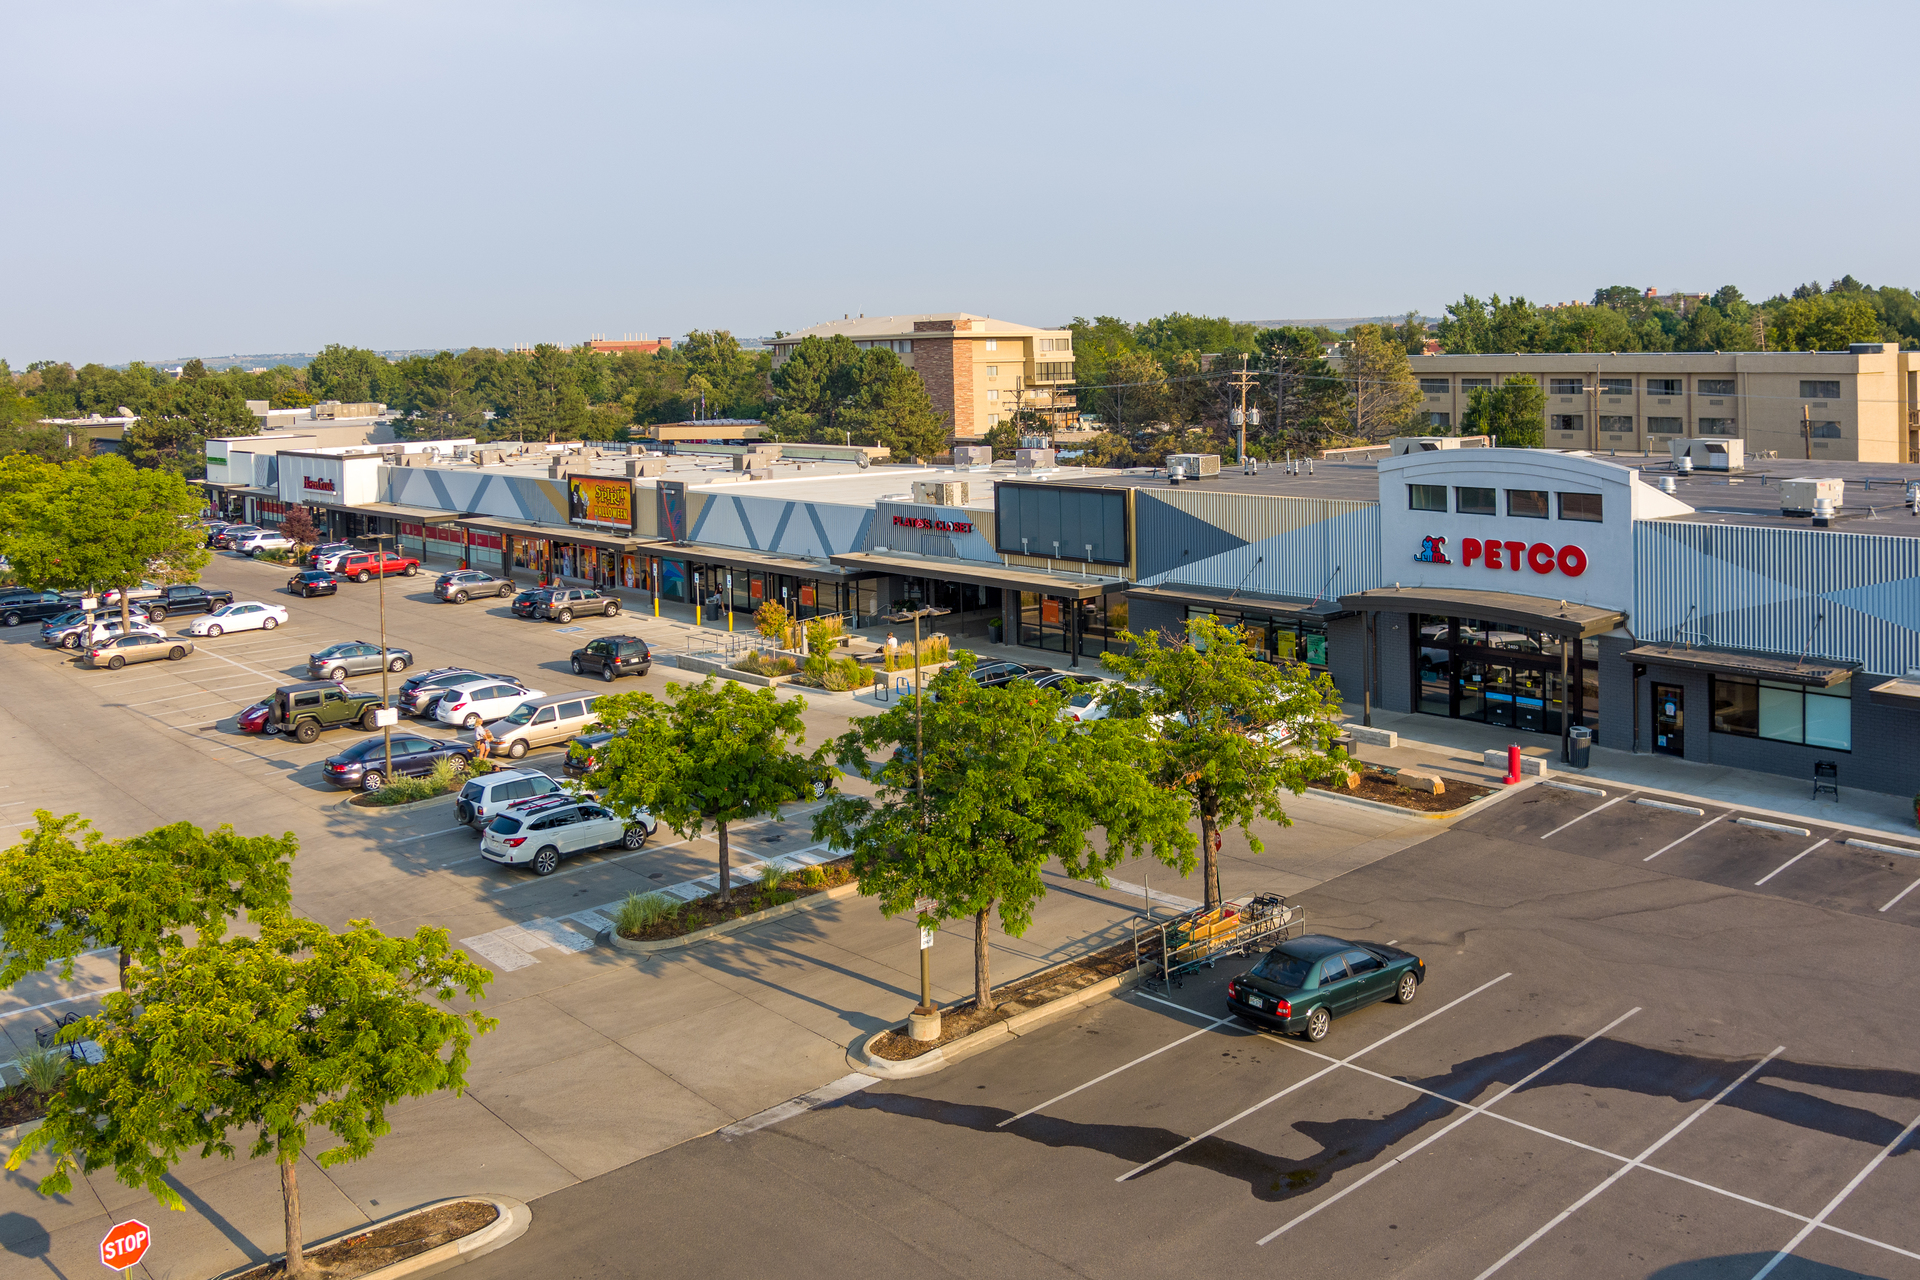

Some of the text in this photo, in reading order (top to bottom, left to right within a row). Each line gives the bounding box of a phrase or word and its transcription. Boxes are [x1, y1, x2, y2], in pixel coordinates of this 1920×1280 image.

[595, 485, 626, 505] SPIRIT
[594, 507, 628, 520] HALLOWEEN
[934, 520, 973, 533] CLOSET
[1462, 537, 1589, 578] PETCO
[104, 1230, 147, 1260] STOP
